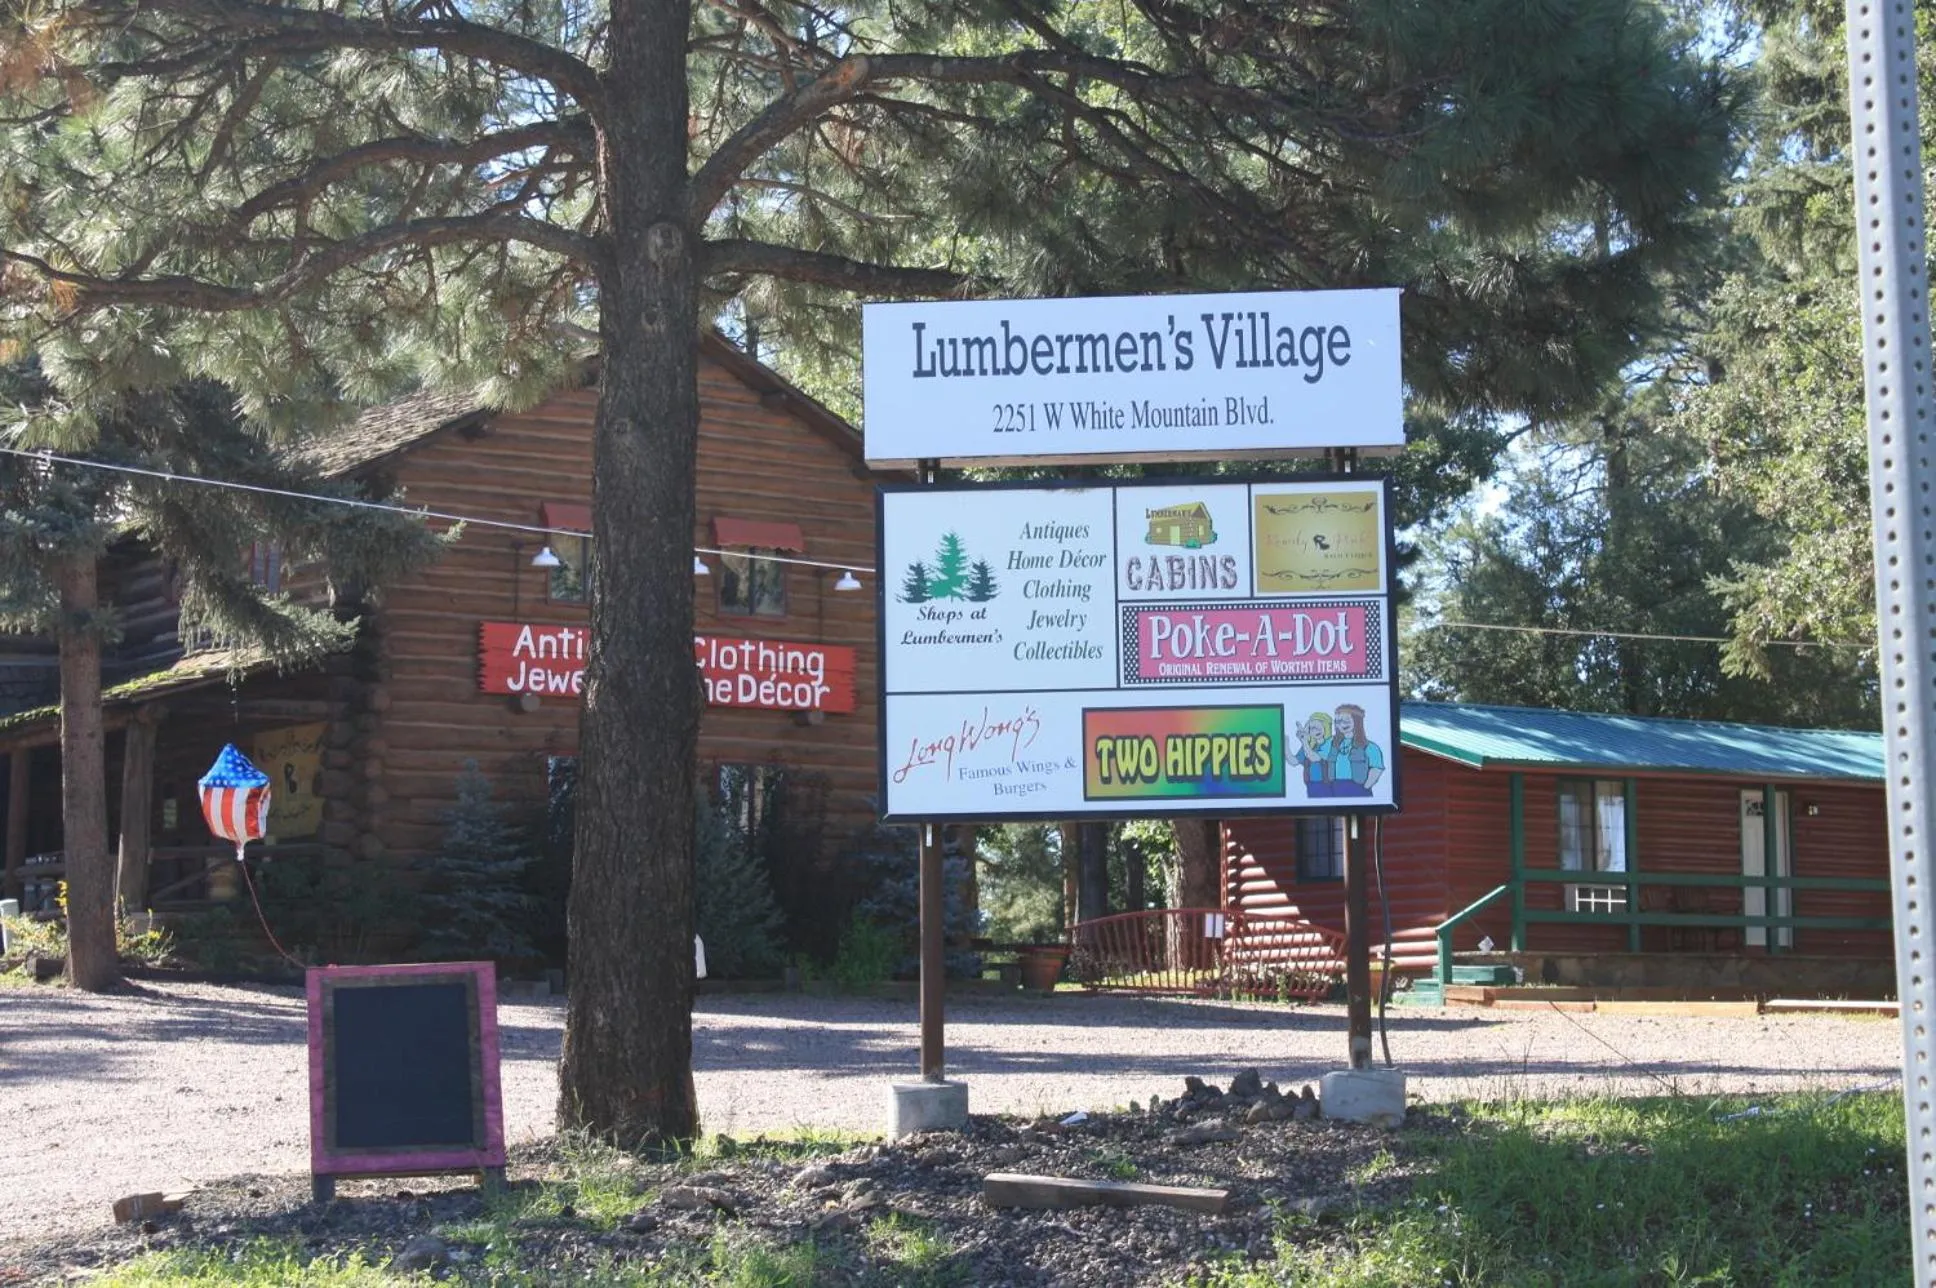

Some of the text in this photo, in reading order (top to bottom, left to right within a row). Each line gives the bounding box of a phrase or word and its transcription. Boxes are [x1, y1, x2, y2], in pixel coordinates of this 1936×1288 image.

[912, 311, 1352, 384] Lumbermen's Village
[993, 396, 1275, 432] 2251 W White Mountain Blvd.
[1020, 520, 1090, 543] Antiques
[1007, 549, 1106, 569] Home Décor
[1127, 554, 1238, 591] CABINS
[1023, 578, 1092, 602] Clothing
[916, 605, 987, 625] Shops at
[1027, 608, 1088, 632] Jewelry
[512, 624, 584, 659] Anti
[901, 628, 1003, 645] Lumbermen's
[1149, 610, 1355, 659] Poke-A-Dot
[1014, 640, 1103, 661] Collectibles
[506, 661, 585, 694] Jewe
[737, 672, 831, 708] Décor
[893, 706, 1040, 784] Long Wong's
[959, 756, 1077, 781] Famous Wings &
[1096, 732, 1273, 784] TWO HIPPIES
[993, 782, 1048, 797] Burgers
